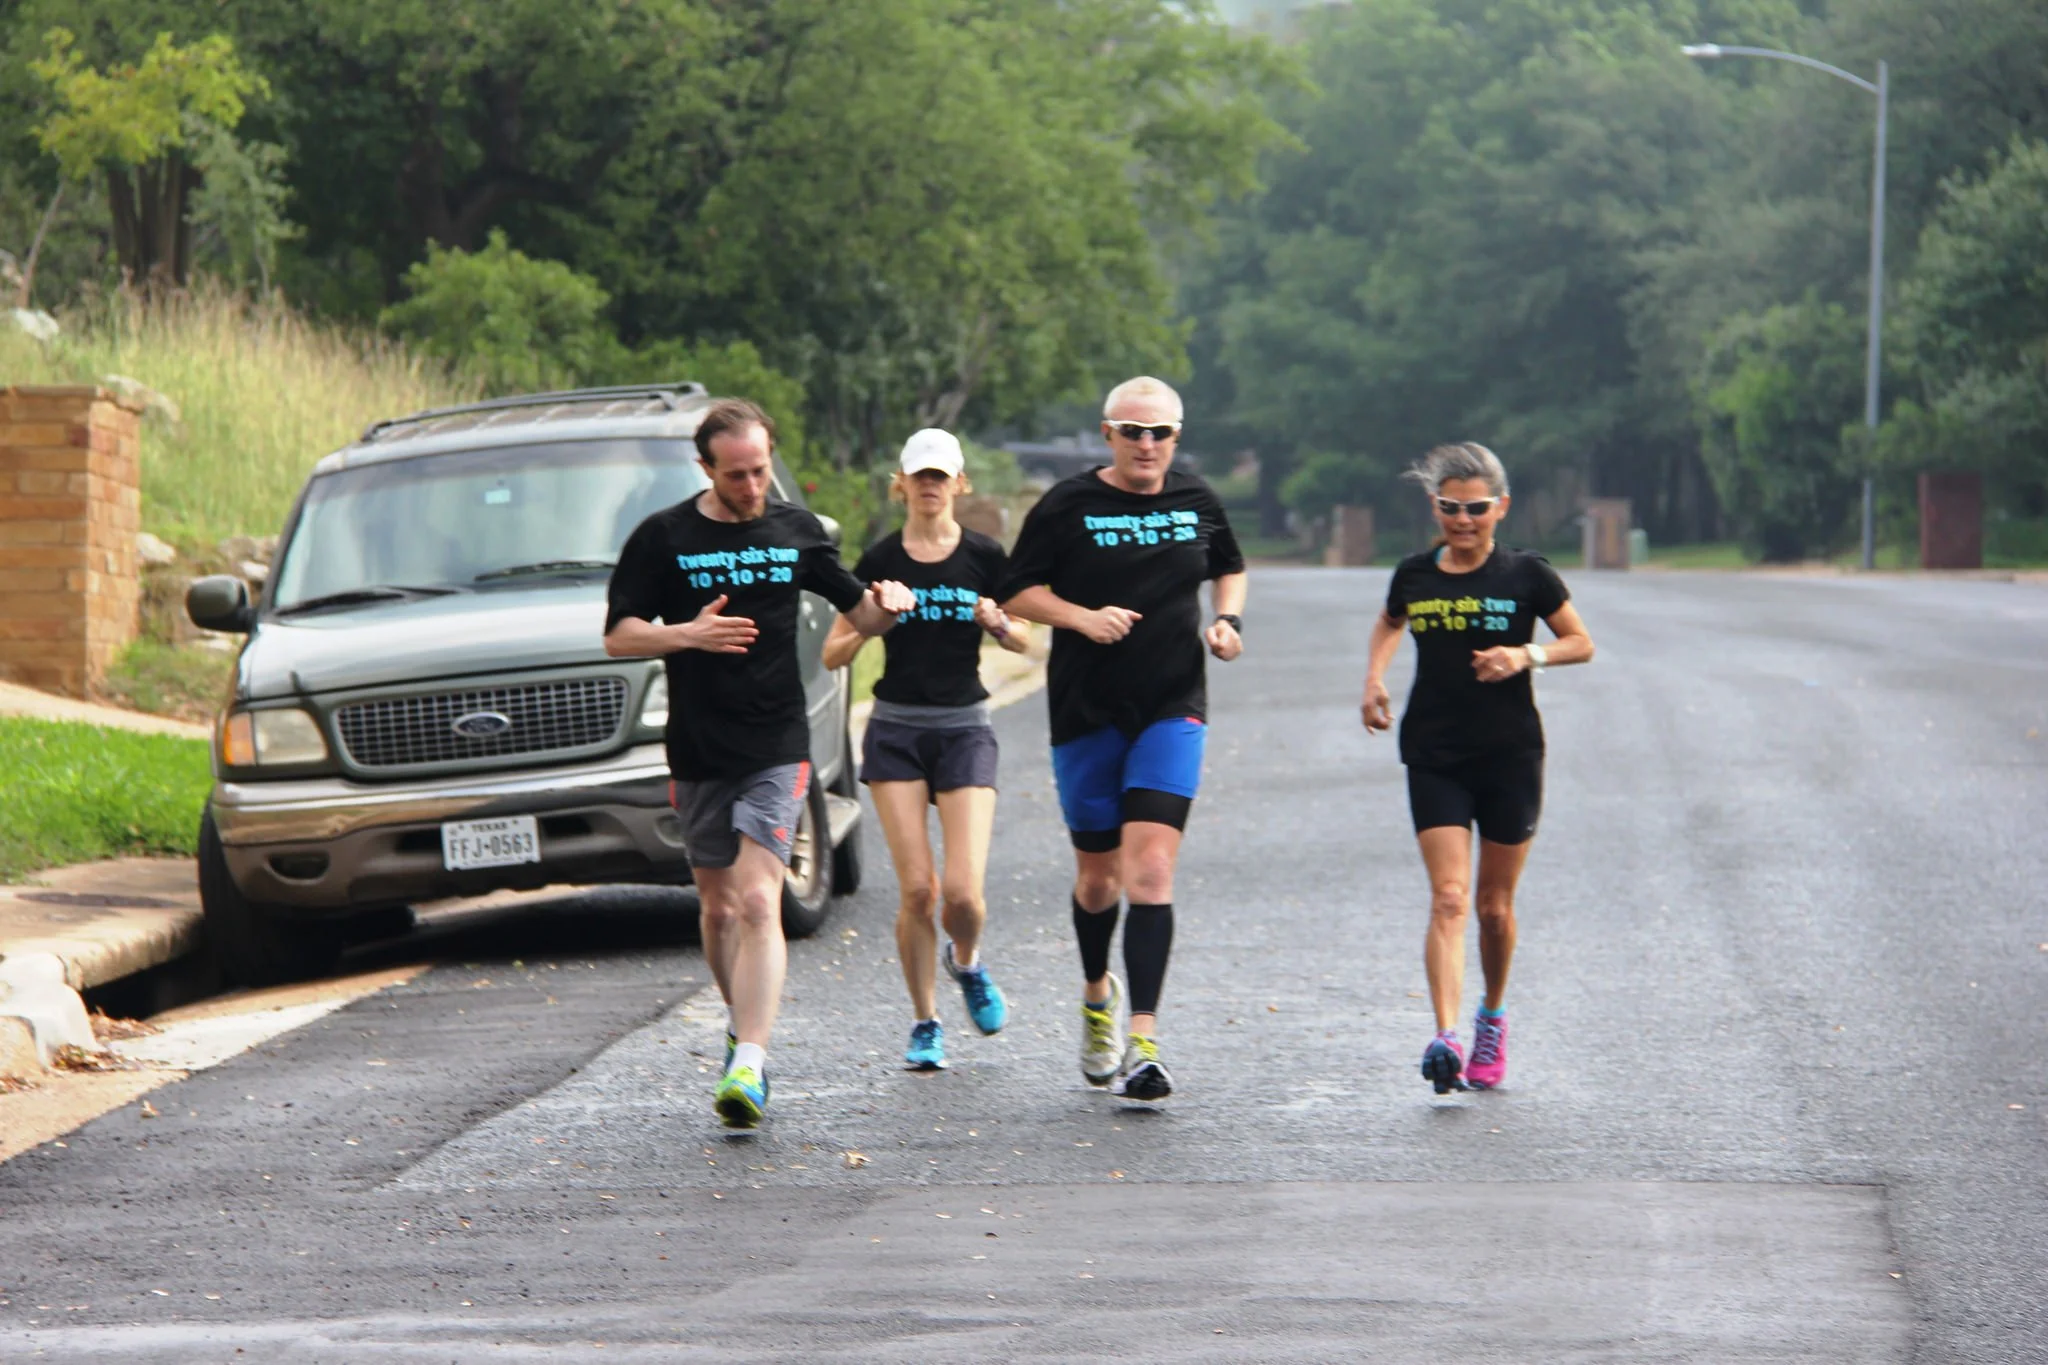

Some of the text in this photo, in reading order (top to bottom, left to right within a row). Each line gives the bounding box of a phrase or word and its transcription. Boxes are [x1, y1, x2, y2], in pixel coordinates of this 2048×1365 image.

[1084, 511, 1199, 532] twenty-six-two
[1093, 530, 1119, 547] 10
[1134, 529, 1159, 545] 10
[676, 546, 799, 570] twenty-six-two
[688, 566, 793, 589] 10 10 20
[919, 605, 942, 621] 10
[1442, 615, 1467, 631] 10
[1483, 614, 1509, 631] 20
